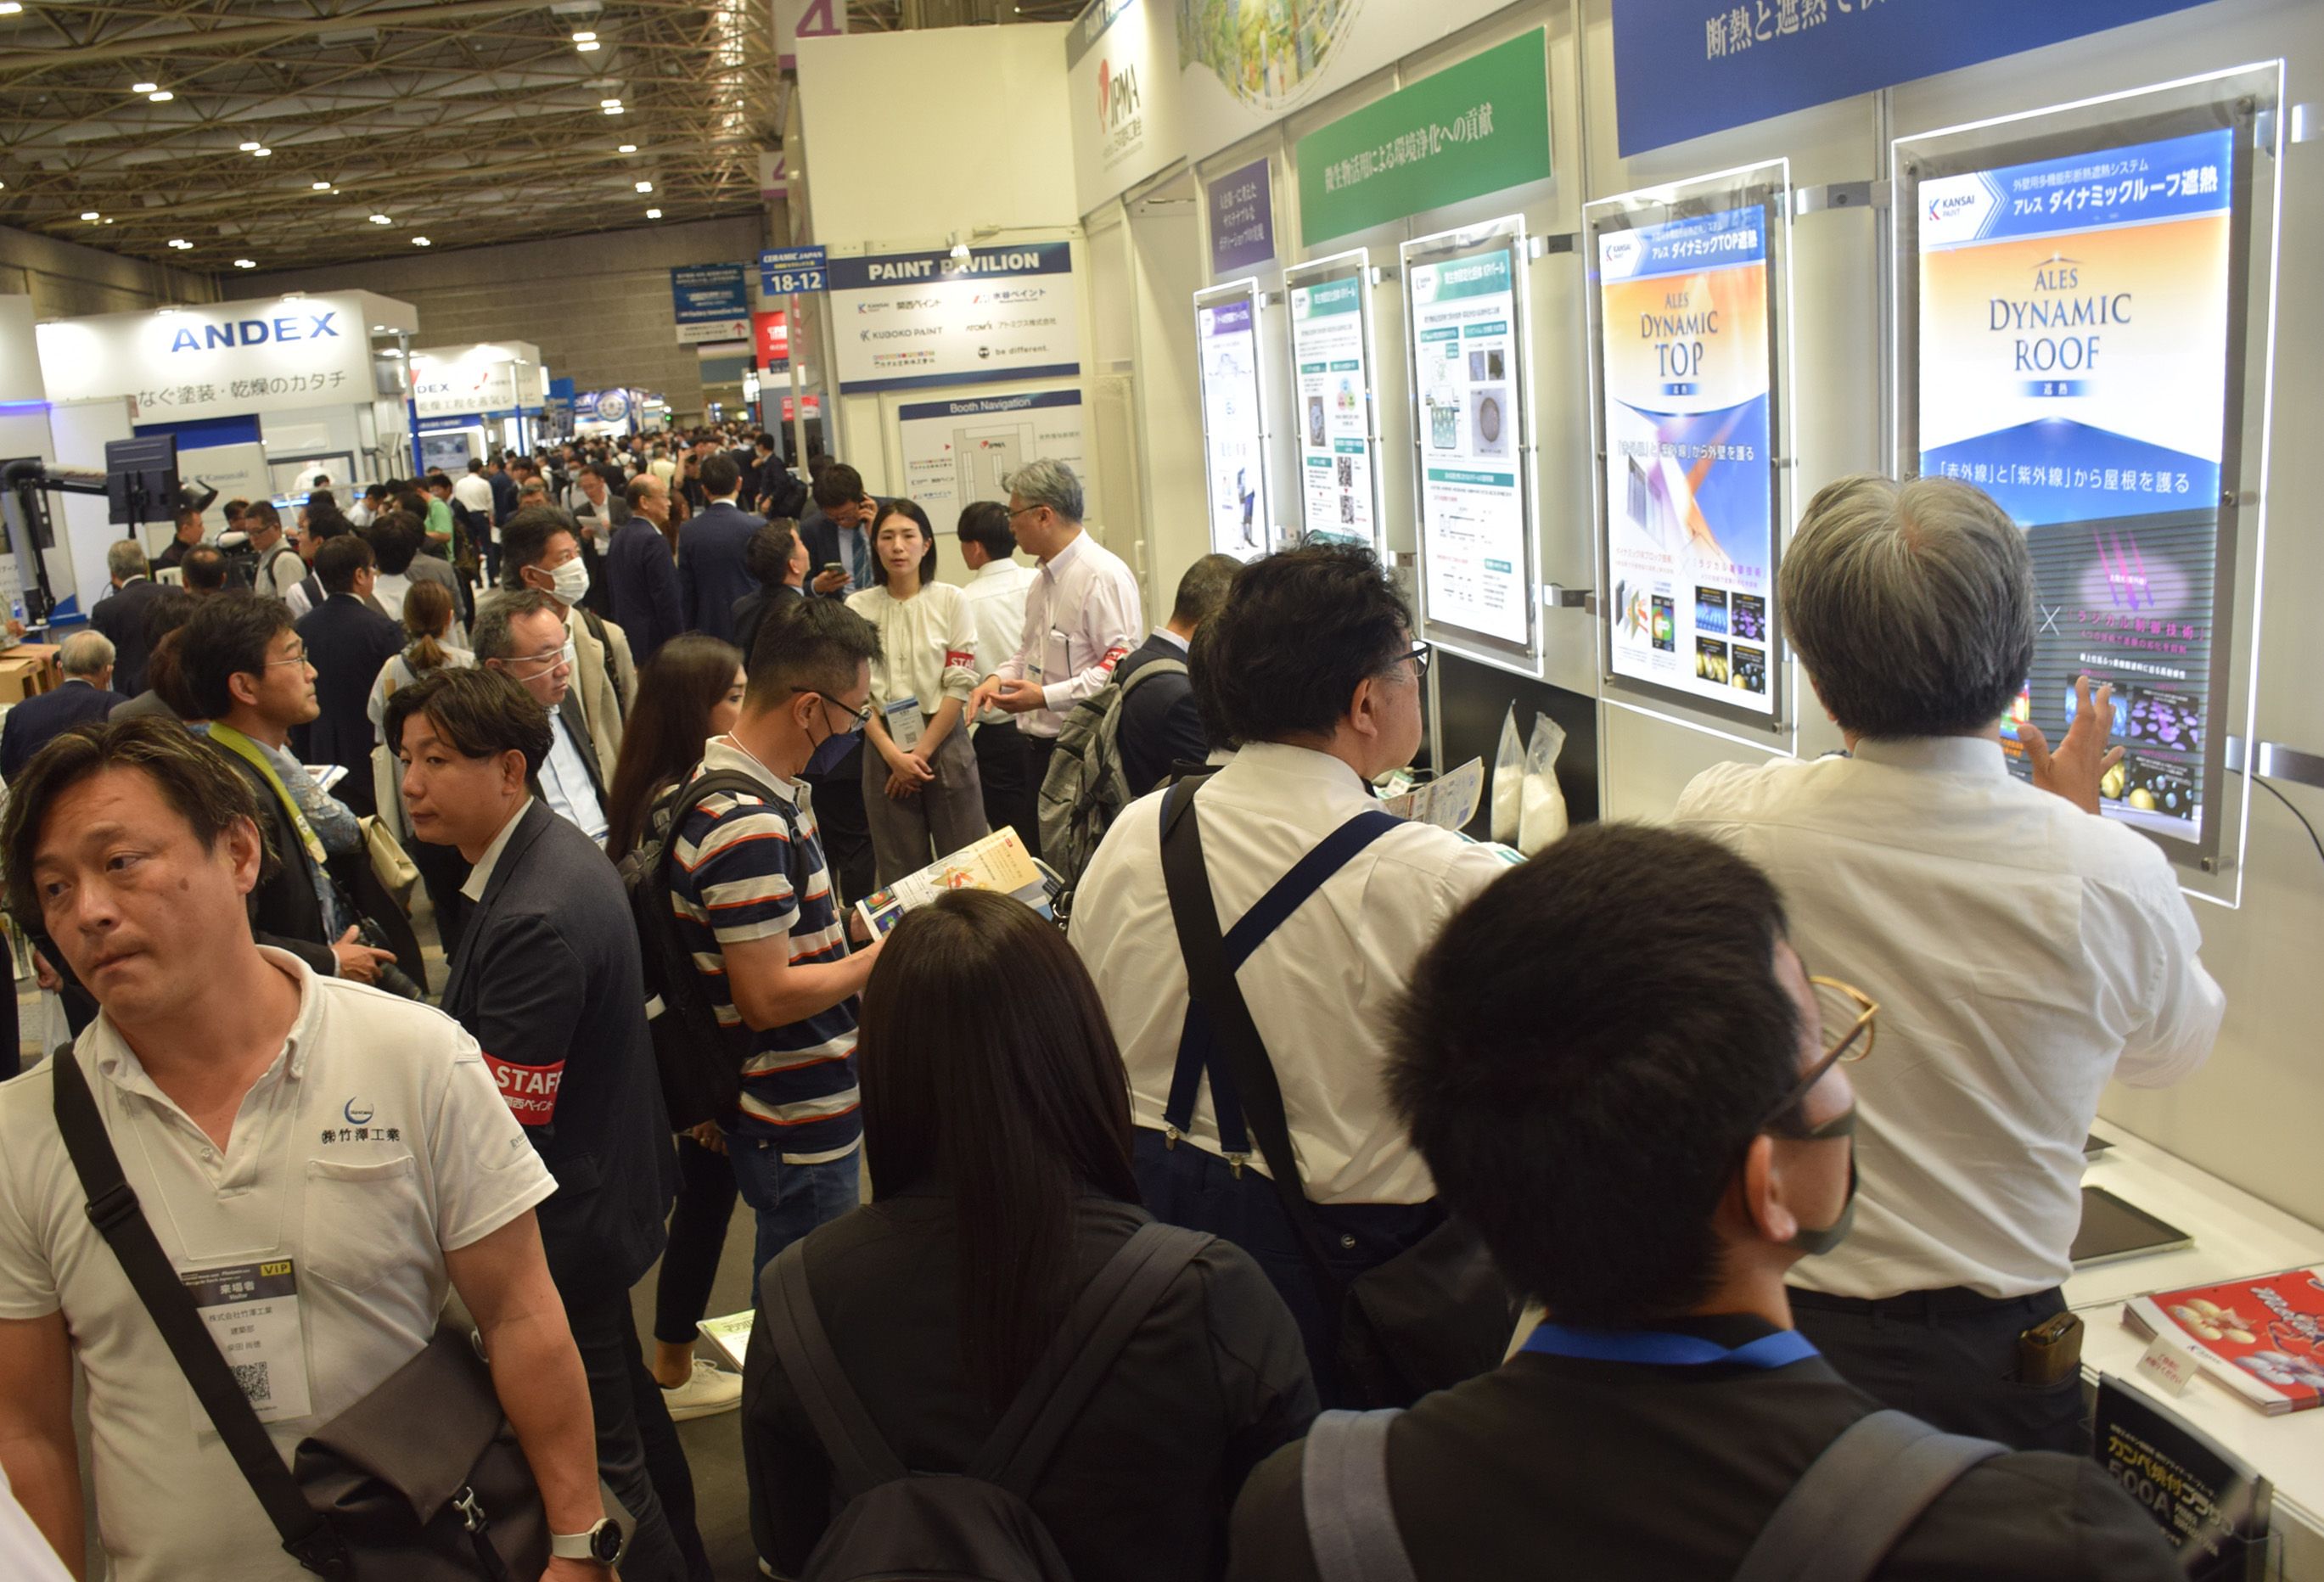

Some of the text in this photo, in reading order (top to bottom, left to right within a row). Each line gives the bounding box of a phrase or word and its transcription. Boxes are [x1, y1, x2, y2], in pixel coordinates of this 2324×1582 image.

[1705, 0, 1886, 60] 断熱と遮熱
[1942, 194, 1974, 209] KANSAI
[2013, 197, 2043, 216] アレス
[868, 260, 933, 280] PAINT
[2034, 268, 2079, 292] ALES
[772, 272, 822, 292] 18-12
[1664, 292, 1688, 309] ALES
[1989, 294, 2132, 331] DYNAMIC
[171, 311, 340, 352] ANDEX
[1641, 311, 1719, 339] DYNAMIC
[1654, 342, 1704, 377] TOP
[2015, 336, 2101, 371] ROOF
[950, 397, 1032, 413] Booth Navigation
[264, 1263, 288, 1275] VIP
